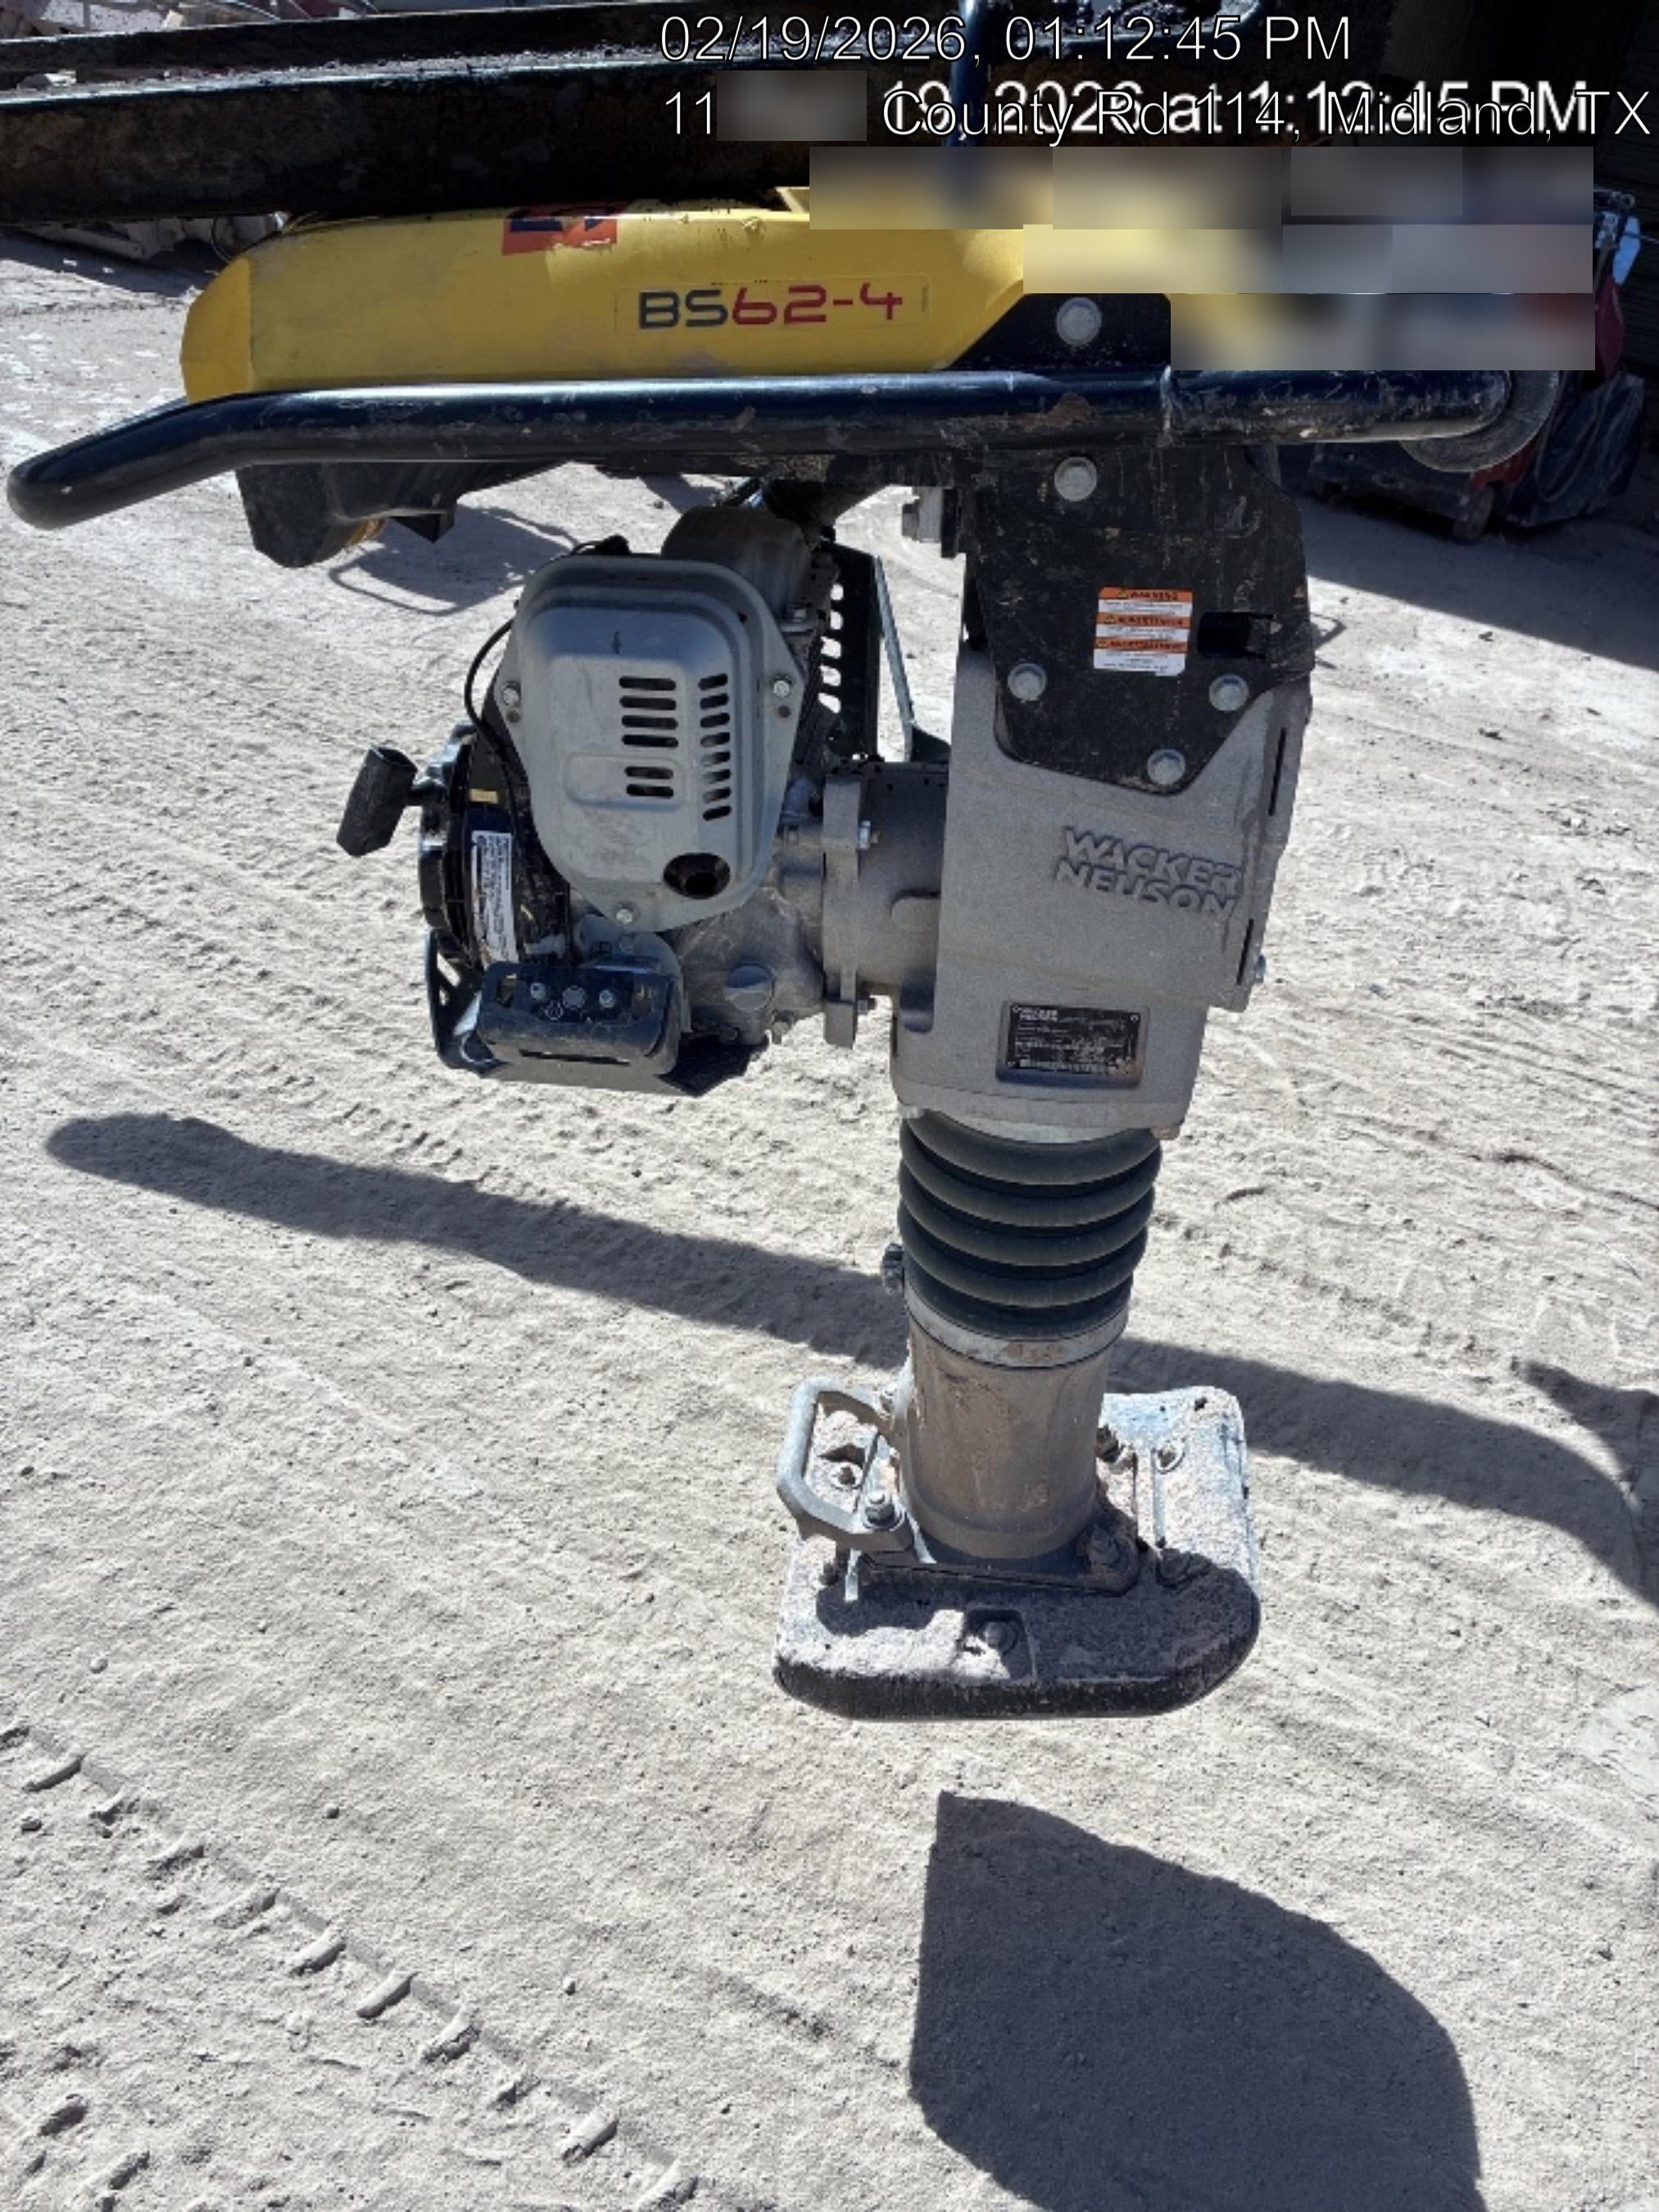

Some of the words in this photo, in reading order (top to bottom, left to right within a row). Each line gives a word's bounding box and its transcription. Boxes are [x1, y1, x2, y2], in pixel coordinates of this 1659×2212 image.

[639, 283, 903, 329] BS62-4
[1054, 855, 1238, 918] NEUSON
[1063, 825, 1244, 899] WACKER
